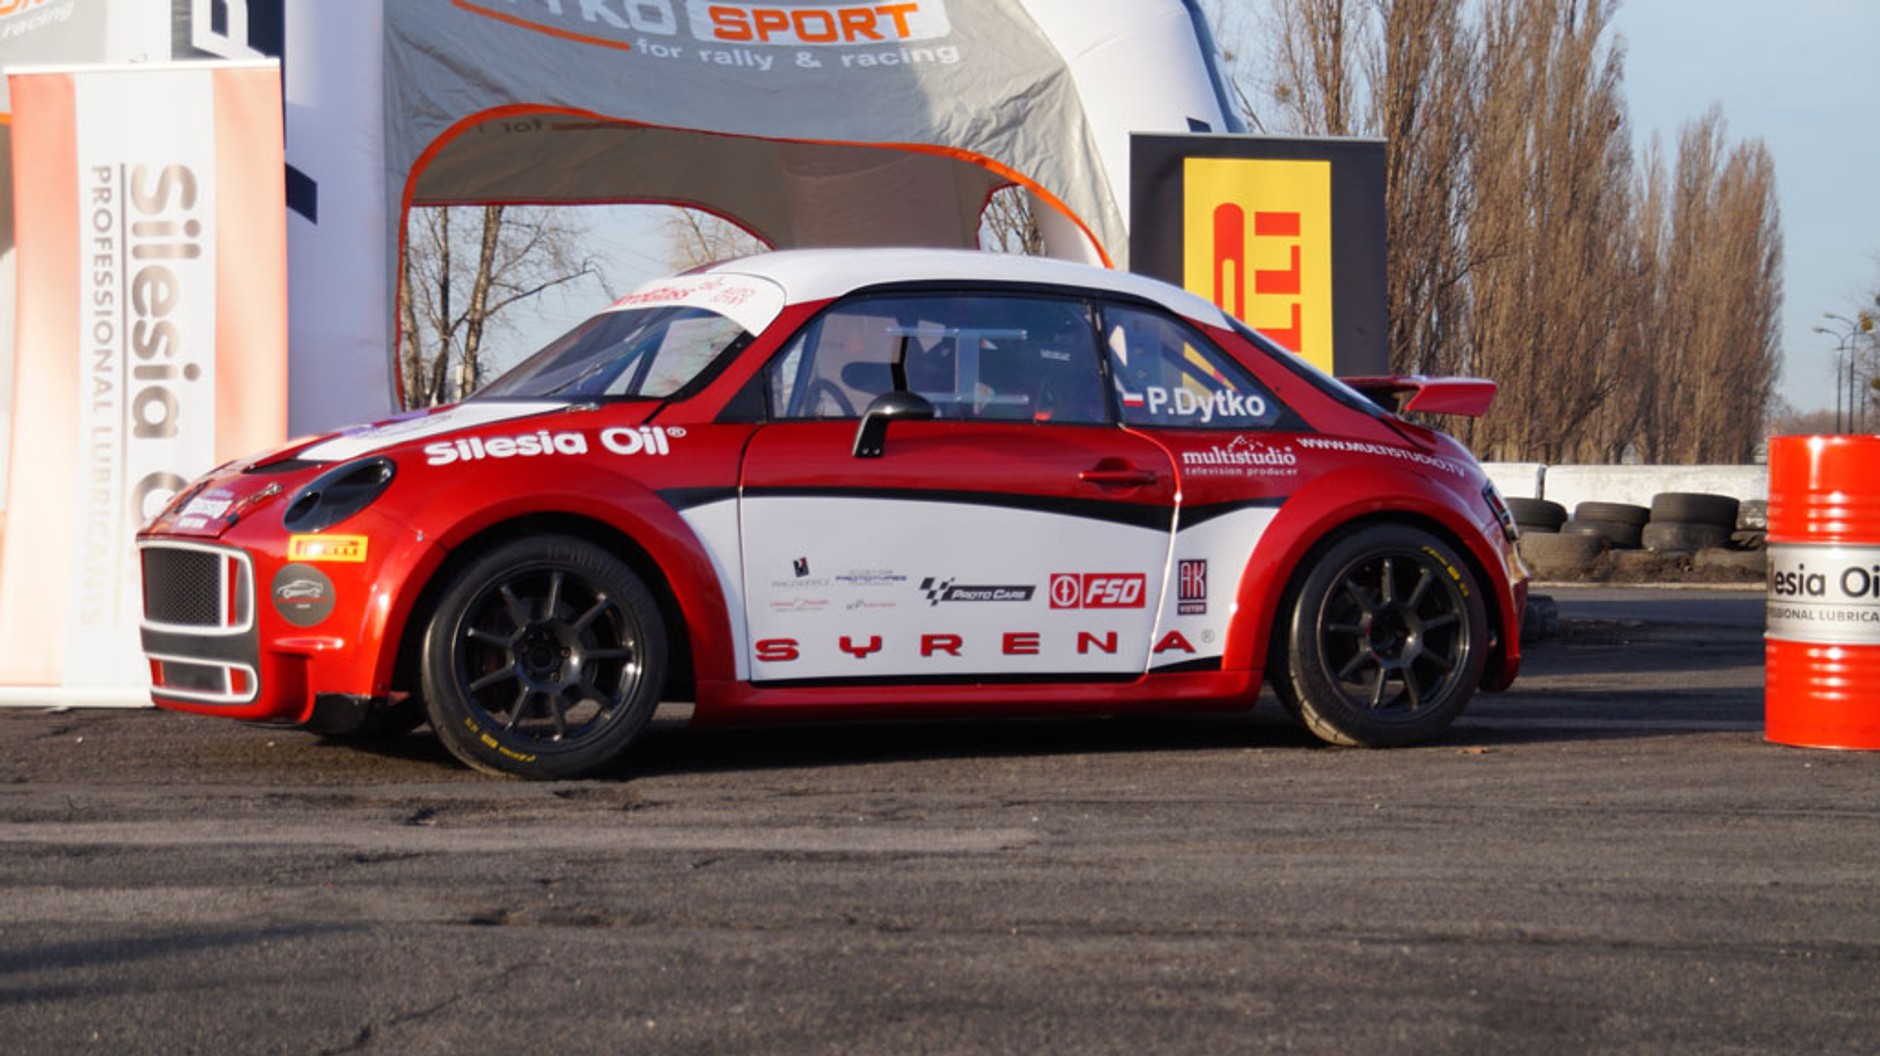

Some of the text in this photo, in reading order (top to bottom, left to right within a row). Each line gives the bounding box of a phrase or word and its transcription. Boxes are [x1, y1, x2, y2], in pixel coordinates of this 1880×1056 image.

[709, 3, 918, 42] SPORT
[637, 38, 960, 71] for rally & racing
[92, 165, 114, 413] PROFESSIONAL
[130, 163, 201, 439] Silesia
[1147, 386, 1266, 423] P.Dytko
[423, 430, 589, 467] Silesia
[1185, 467, 1299, 477] television producer
[1085, 577, 1144, 604] FSO
